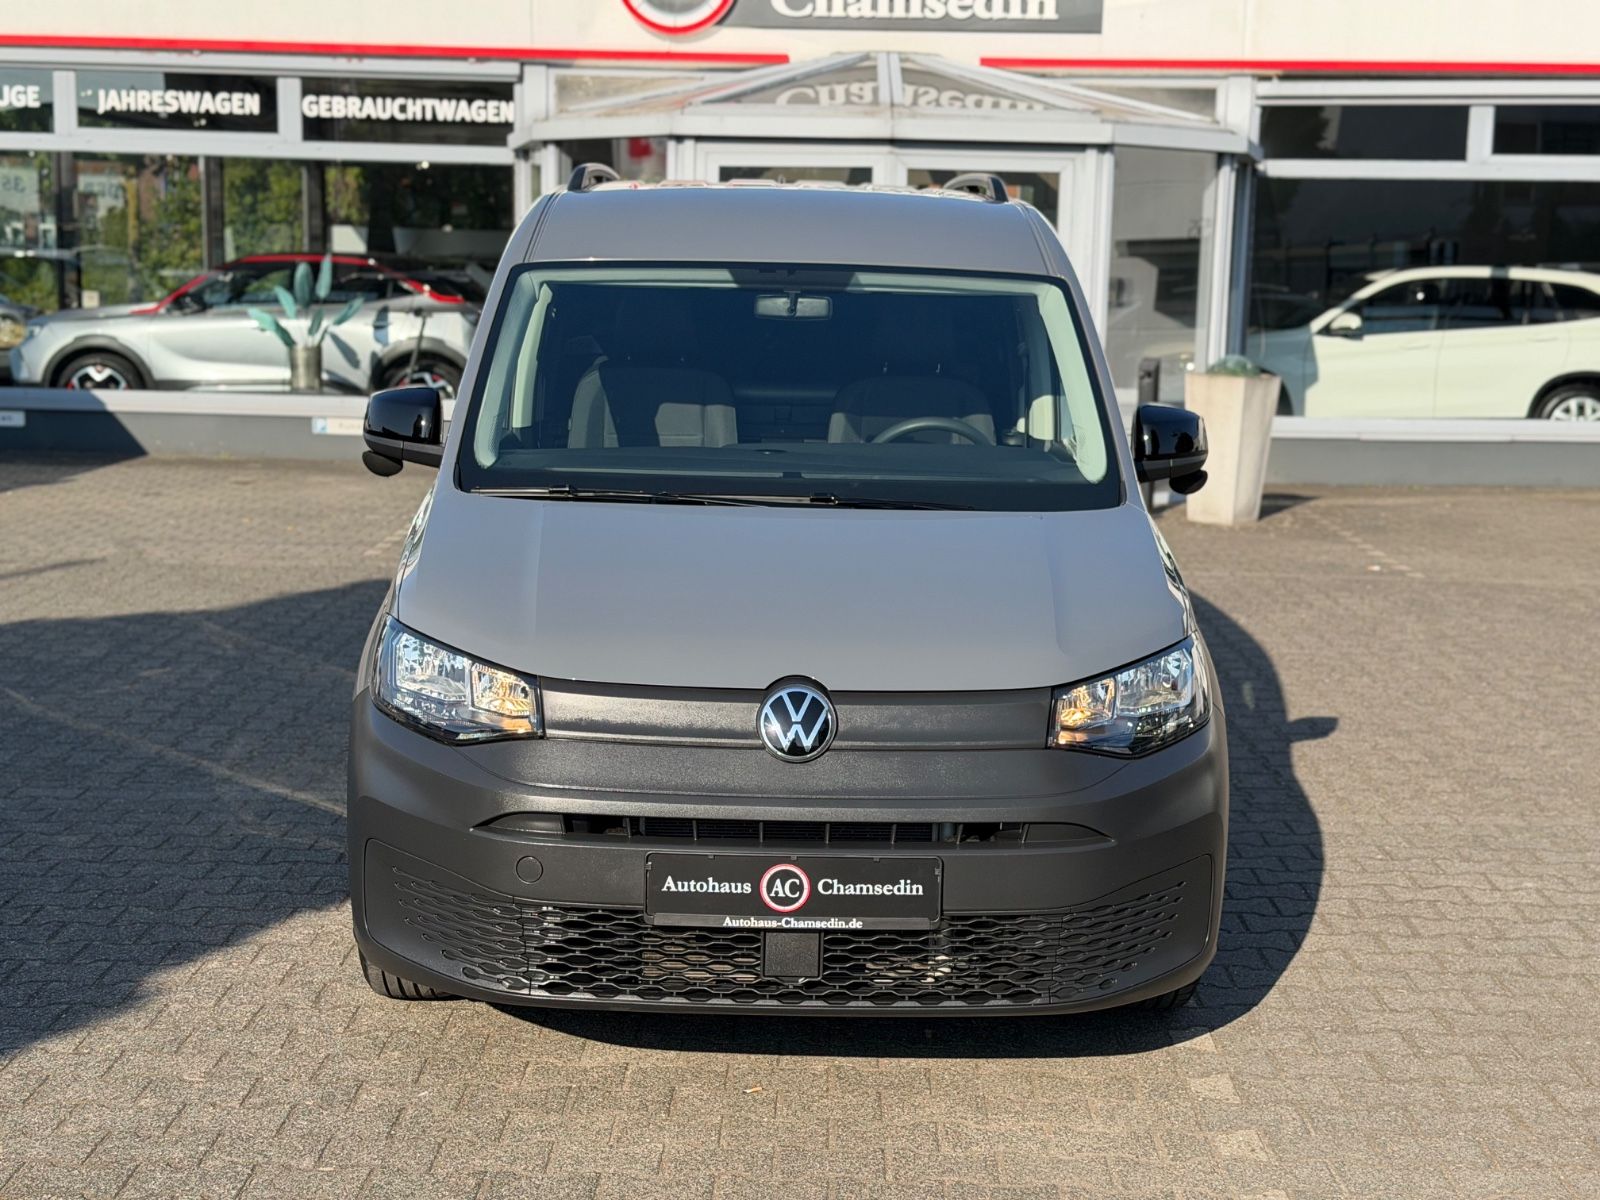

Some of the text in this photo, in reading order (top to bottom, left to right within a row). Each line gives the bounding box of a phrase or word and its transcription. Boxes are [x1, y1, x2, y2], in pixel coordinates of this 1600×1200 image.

[97, 88, 261, 115] JAHRESWAGEN
[301, 94, 514, 123] GEBRAUCHTWAGEN
[661, 875, 924, 898] Autohaus AC Chamsedin
[722, 916, 863, 929] Autohaus-Chamsedin.de
